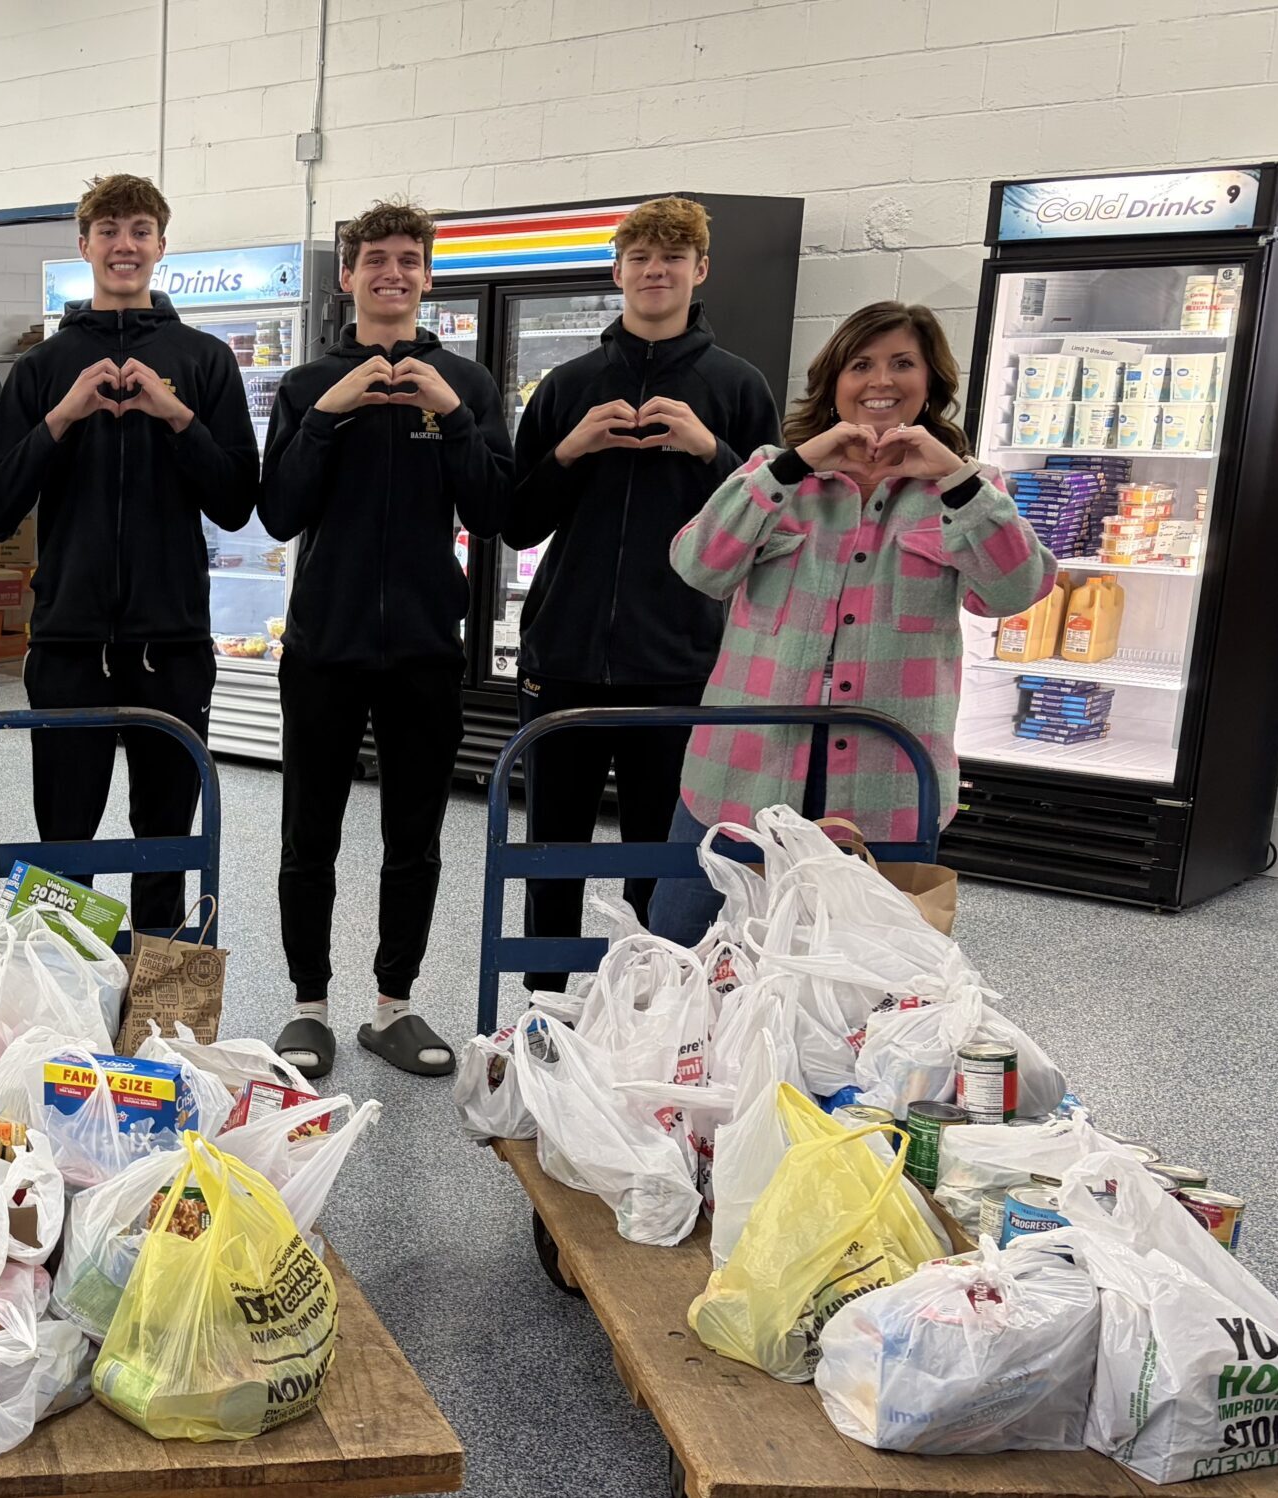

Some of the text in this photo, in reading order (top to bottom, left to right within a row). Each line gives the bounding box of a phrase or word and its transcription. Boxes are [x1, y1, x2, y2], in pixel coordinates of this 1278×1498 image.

[1225, 184, 1241, 204] 9
[1037, 193, 1217, 223] Cold Drinks
[168, 269, 243, 294] Drinks
[279, 271, 287, 284] 4
[1071, 344, 1085, 352] Limit
[1090, 346, 1100, 354] this
[1101, 348, 1114, 356] door
[30, 883, 78, 911] 20 DAYS
[46, 878, 70, 895] Unbox
[63, 1069, 153, 1094] FAMIY SIZE
[176, 1088, 197, 1112] Crisp
[1010, 1215, 1059, 1231] PROGRESSO
[298, 1313, 311, 1331] ON
[307, 1297, 328, 1319] OUR
[1216, 1318, 1278, 1360] YO
[266, 1373, 312, 1404] NOW
[1218, 1364, 1278, 1399] HO
[889, 1407, 934, 1425] lmar
[1218, 1398, 1278, 1421] IMPROV
[1218, 1416, 1278, 1453] STO
[1194, 1449, 1278, 1478] MENA
